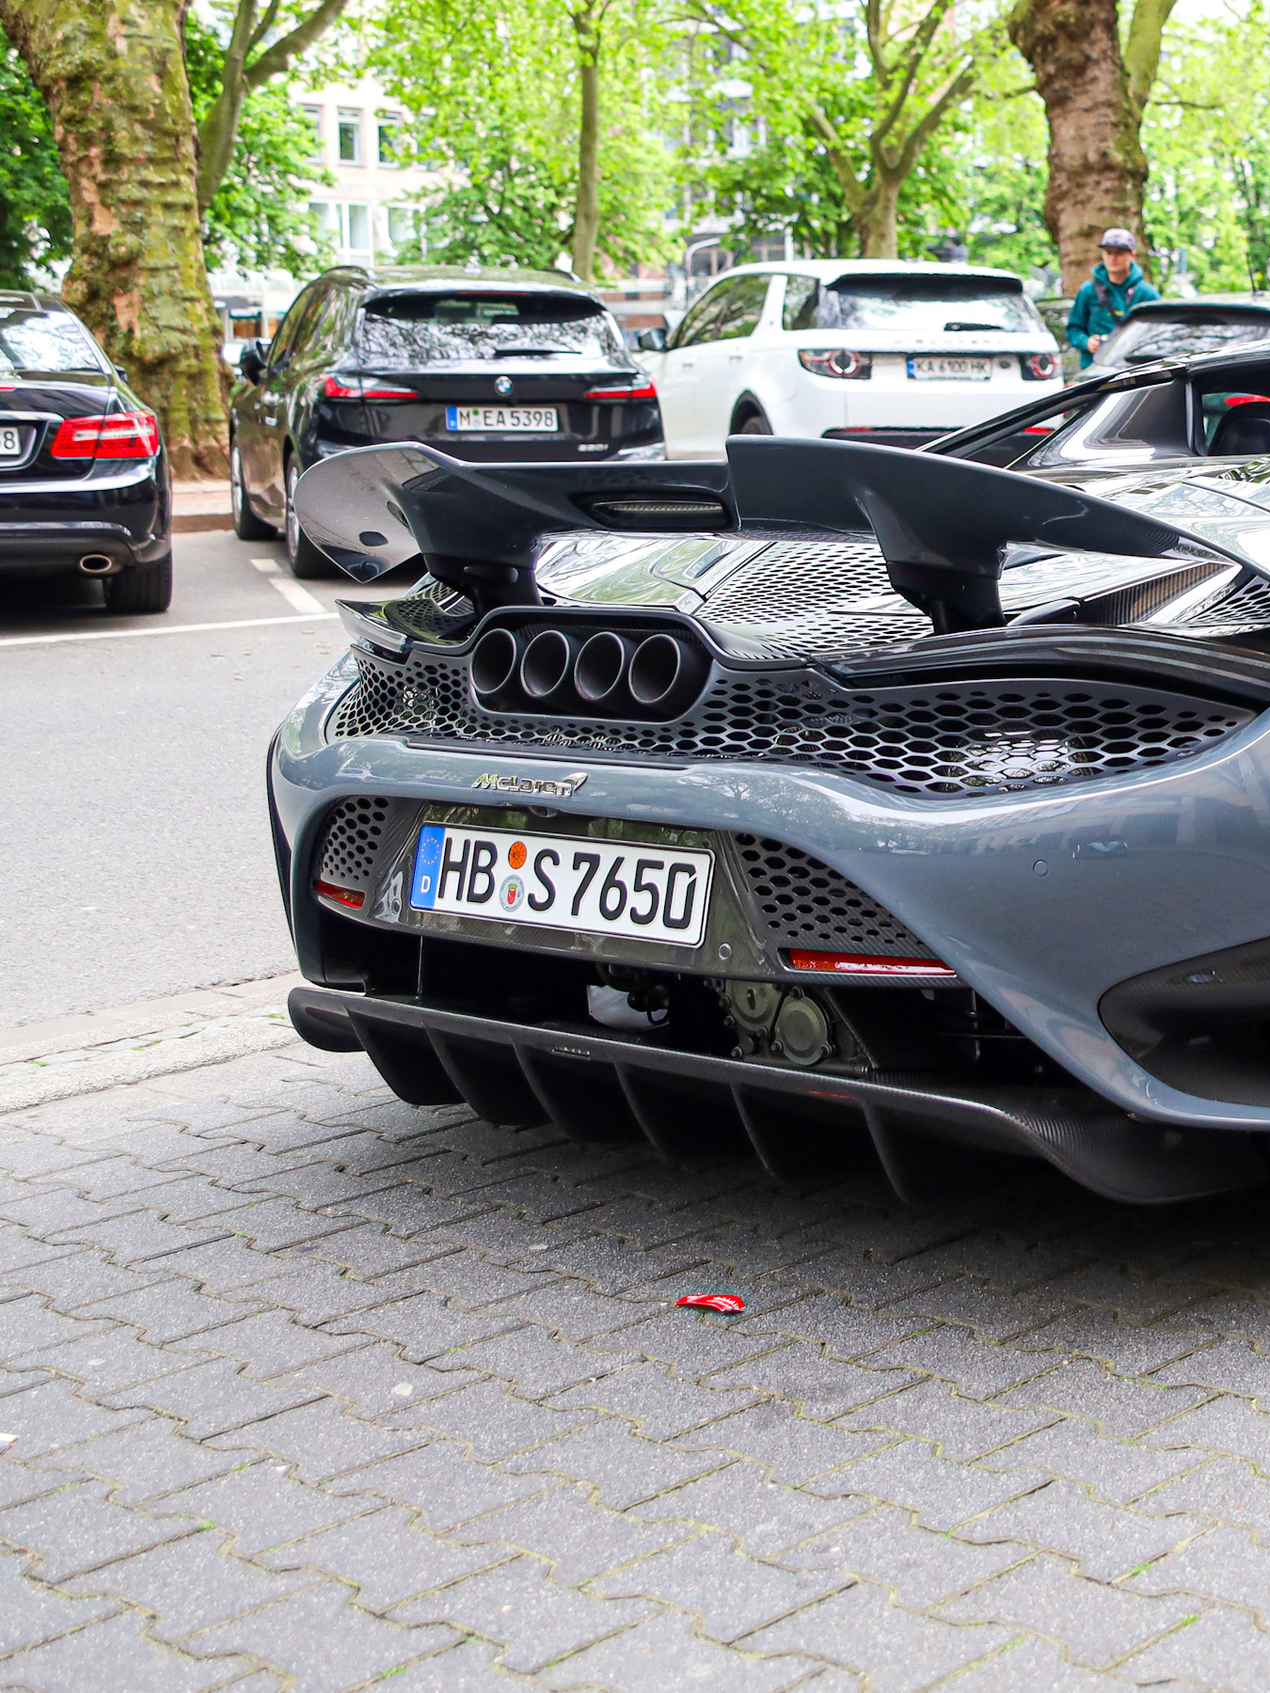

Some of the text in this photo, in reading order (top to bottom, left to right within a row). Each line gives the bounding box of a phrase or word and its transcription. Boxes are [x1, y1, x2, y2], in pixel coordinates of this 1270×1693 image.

[459, 410, 554, 427] M EA 5398
[471, 772, 577, 797] McLaren
[420, 874, 431, 894] D
[438, 837, 499, 904] HB
[527, 849, 561, 912] S
[570, 851, 698, 930] 7650
